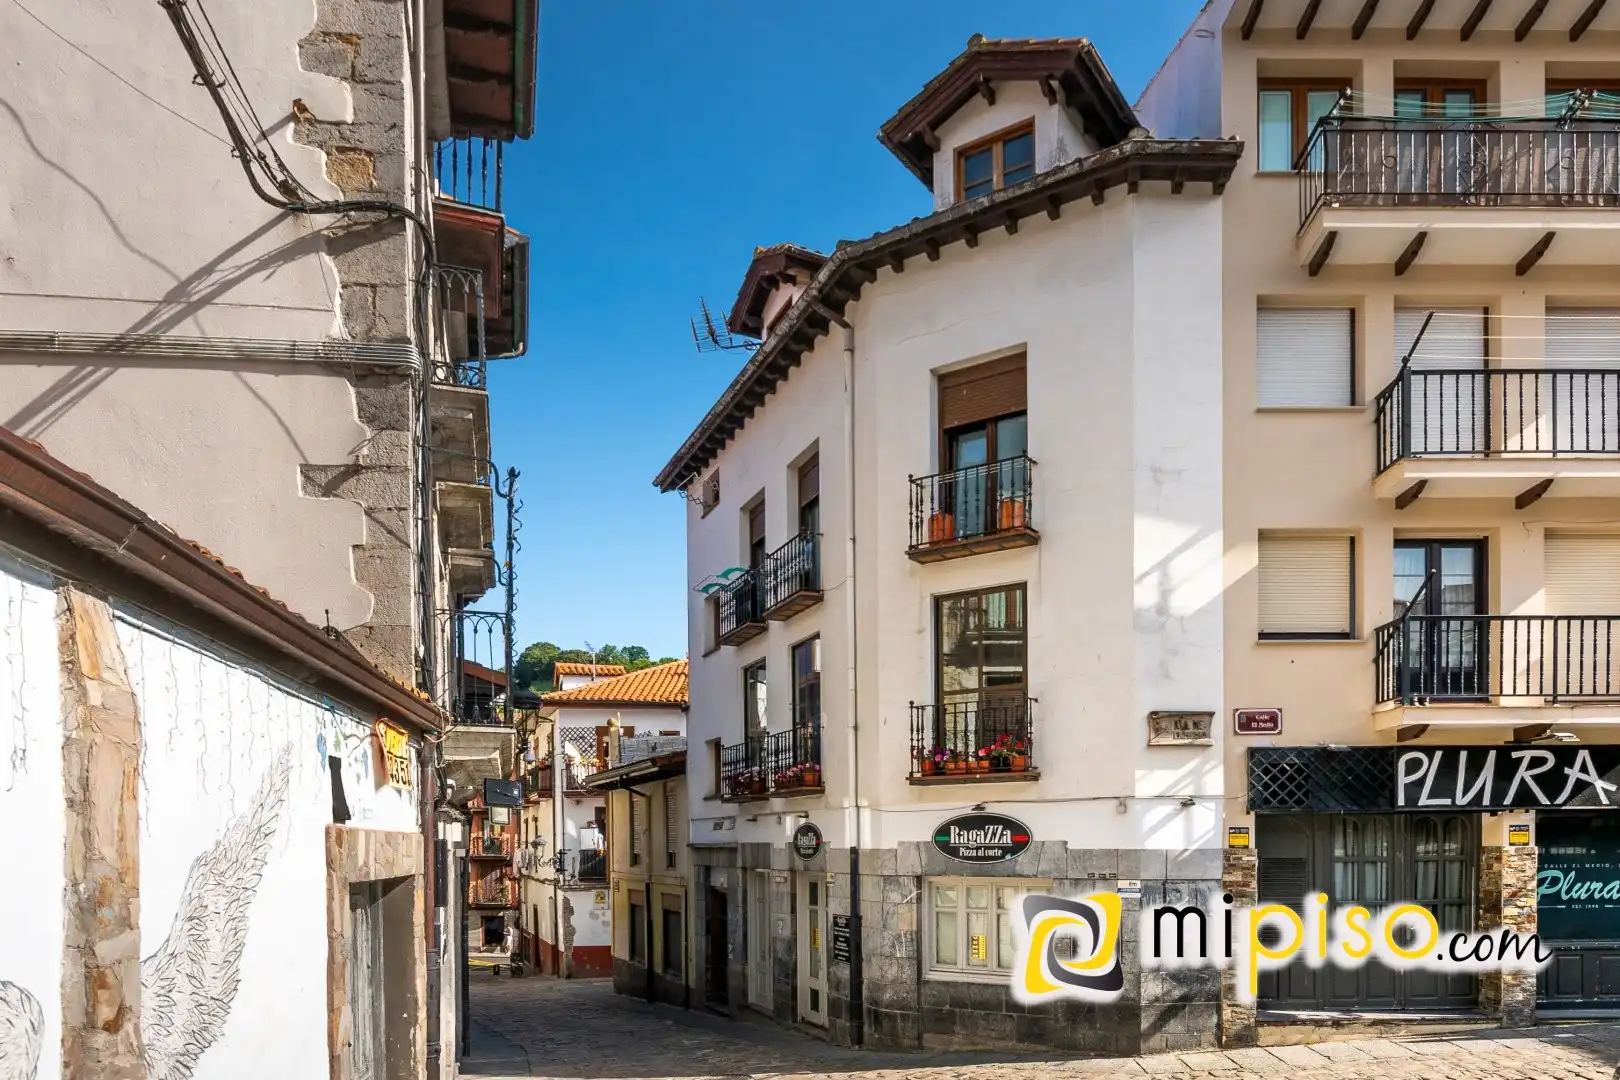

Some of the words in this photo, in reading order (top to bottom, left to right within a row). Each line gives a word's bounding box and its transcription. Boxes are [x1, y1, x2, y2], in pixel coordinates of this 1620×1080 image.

[1398, 750, 1618, 806] PLURA
[960, 847, 977, 857] Pizza
[977, 847, 985, 857] al
[985, 847, 1002, 857] corte
